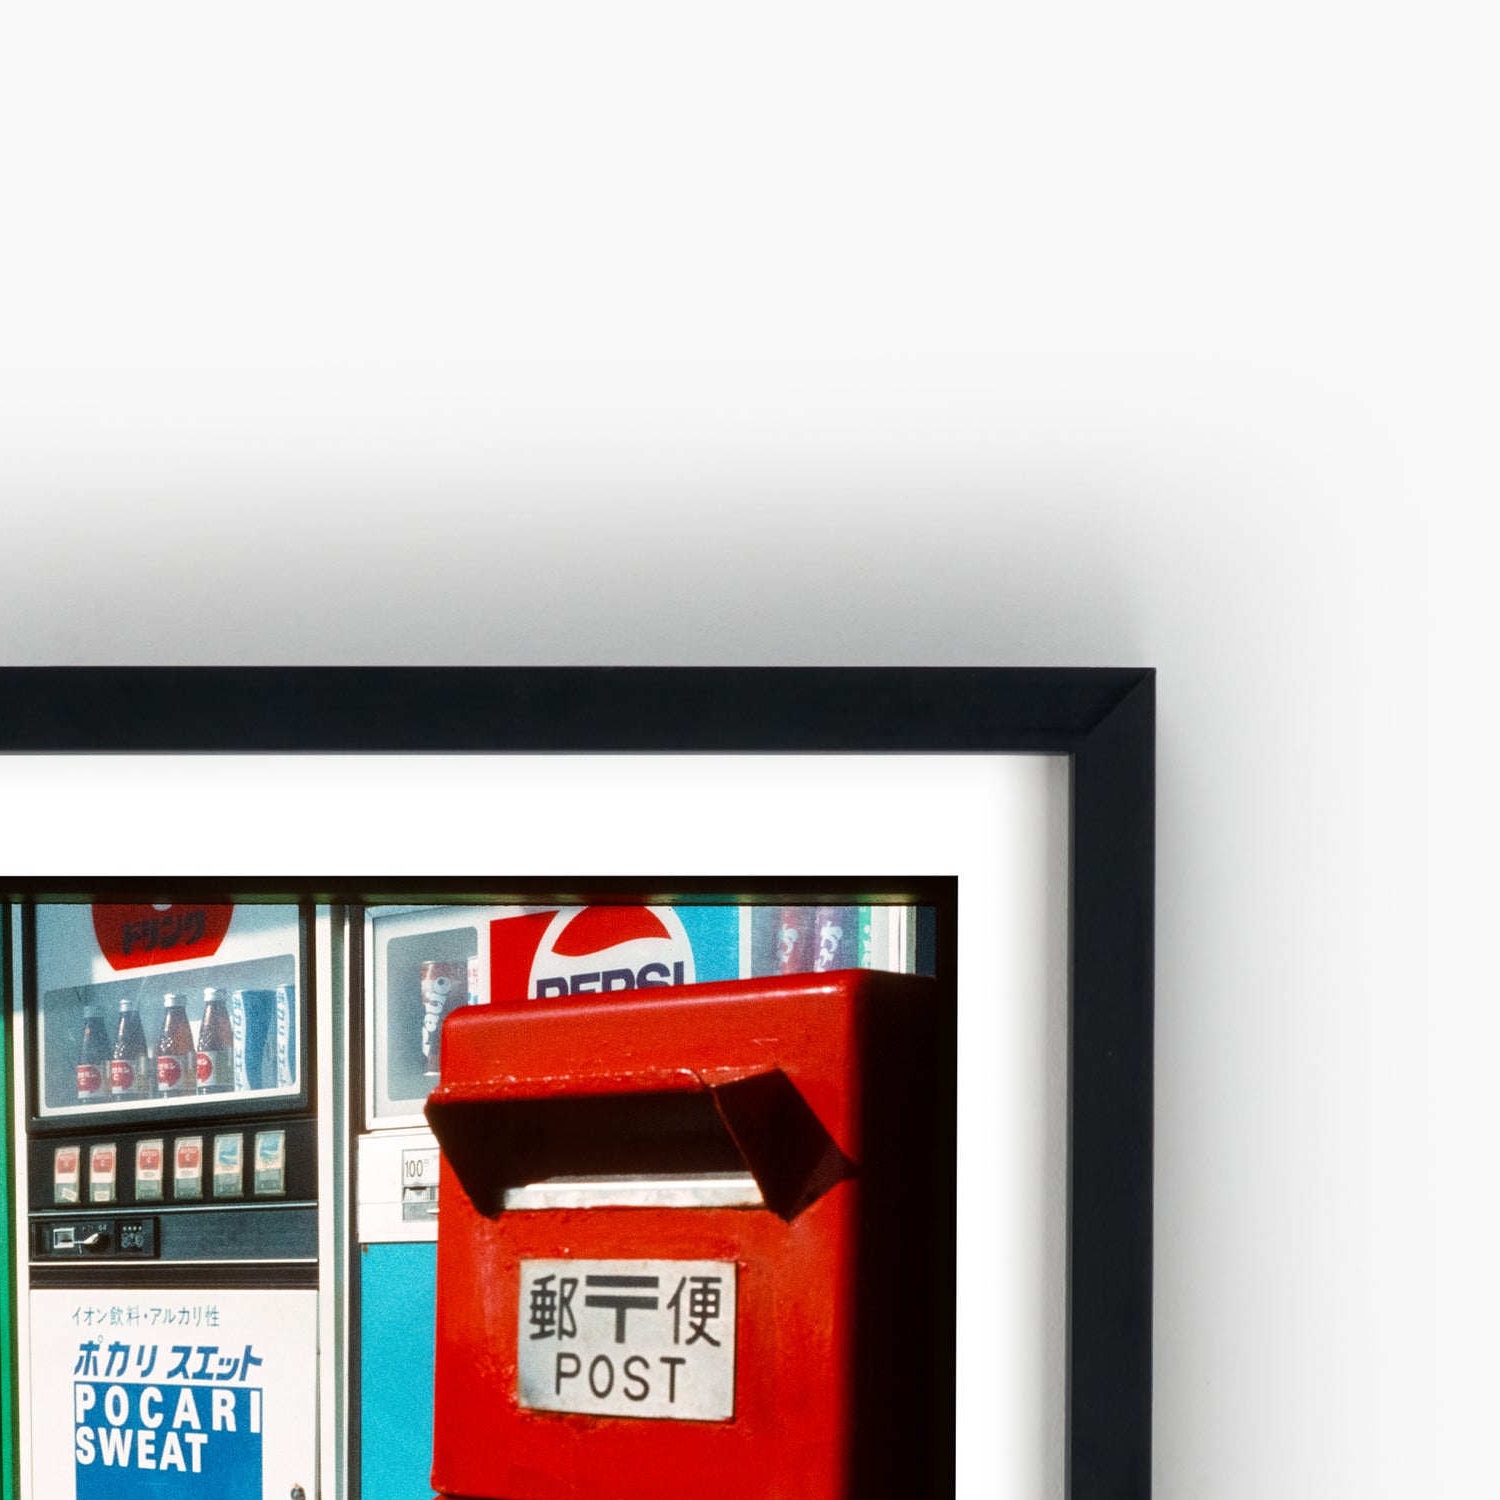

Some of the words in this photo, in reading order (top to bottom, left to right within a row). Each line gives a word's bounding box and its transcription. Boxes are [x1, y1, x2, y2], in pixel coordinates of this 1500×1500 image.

[122, 910, 206, 956] ドリンク
[72, 1304, 220, 1328] イオン飲料・アルカリ性
[74, 1335, 158, 1378] ポカリ
[166, 1344, 263, 1382] スエット
[555, 1352, 687, 1404] POST
[75, 1382, 262, 1434] POCARI
[76, 1426, 209, 1473] SWEAT
